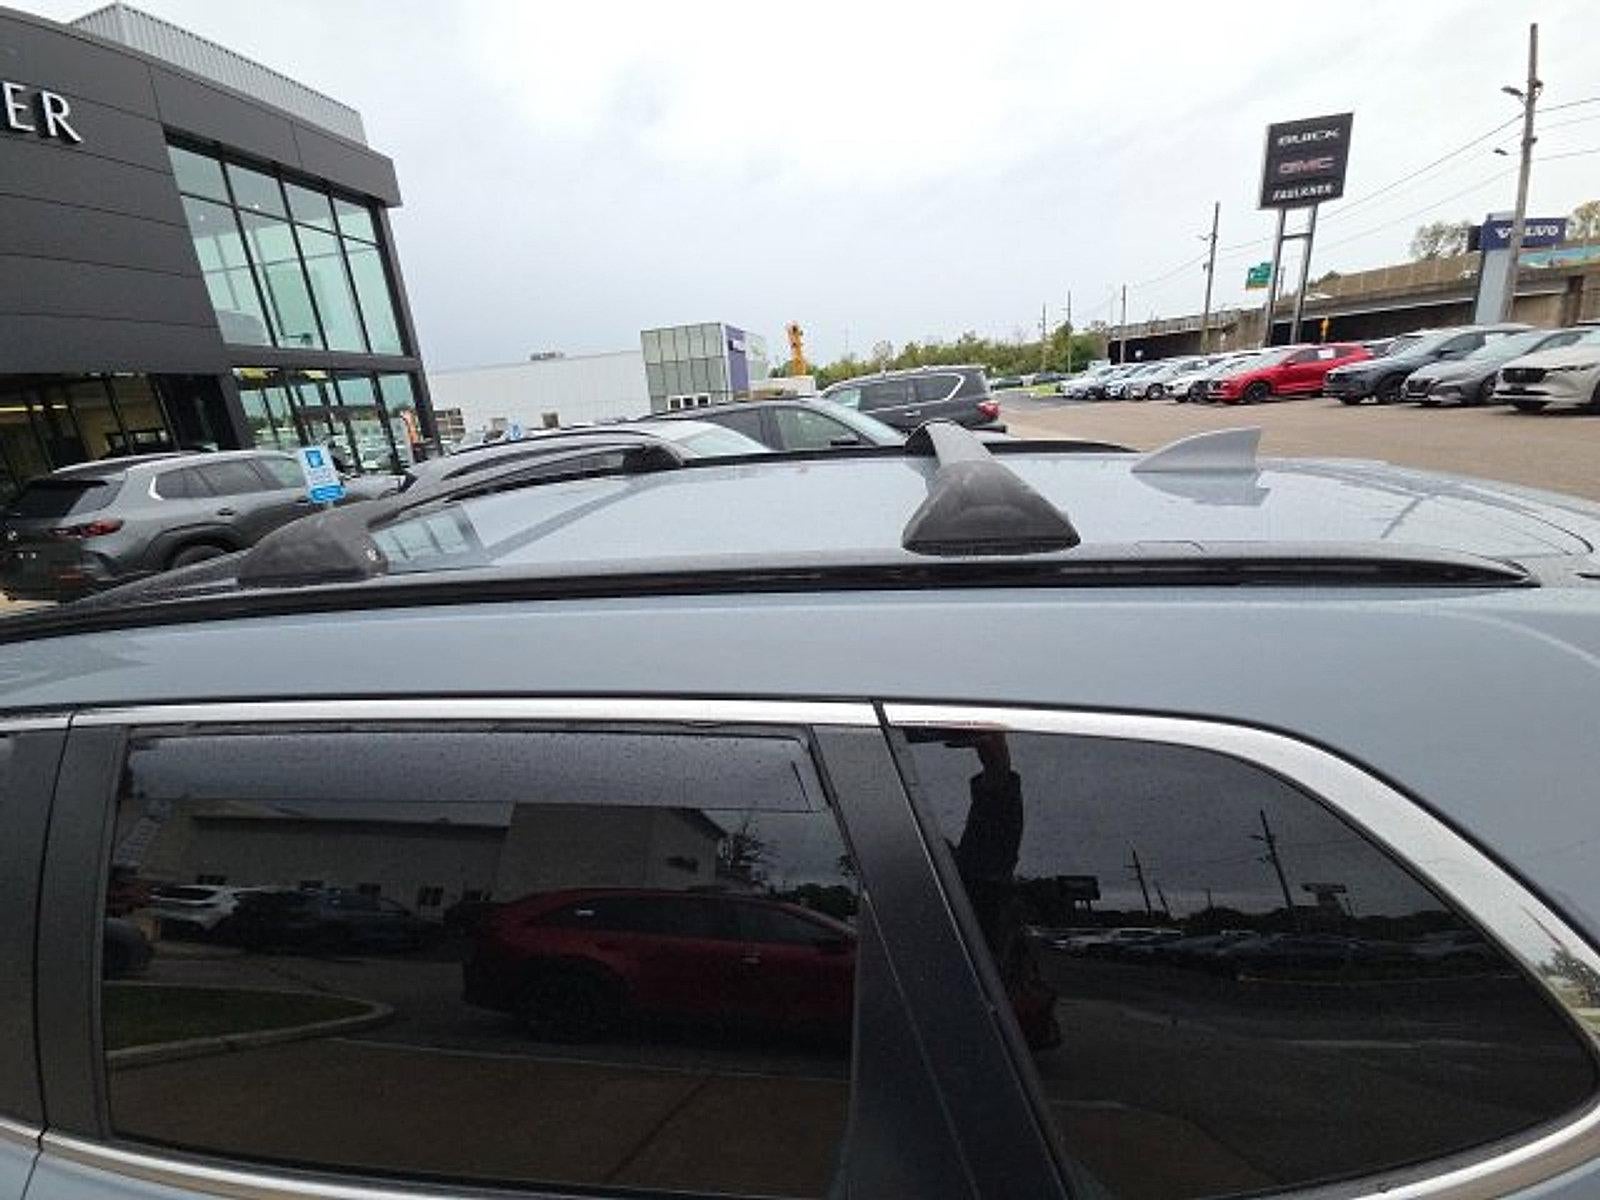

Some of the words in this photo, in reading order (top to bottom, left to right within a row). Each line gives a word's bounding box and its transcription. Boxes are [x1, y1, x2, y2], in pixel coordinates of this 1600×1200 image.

[1278, 128, 1340, 146] BUICK
[1279, 157, 1335, 174] GMC
[1272, 184, 1333, 201] FAULKNER
[1495, 224, 1559, 239] VLVO
